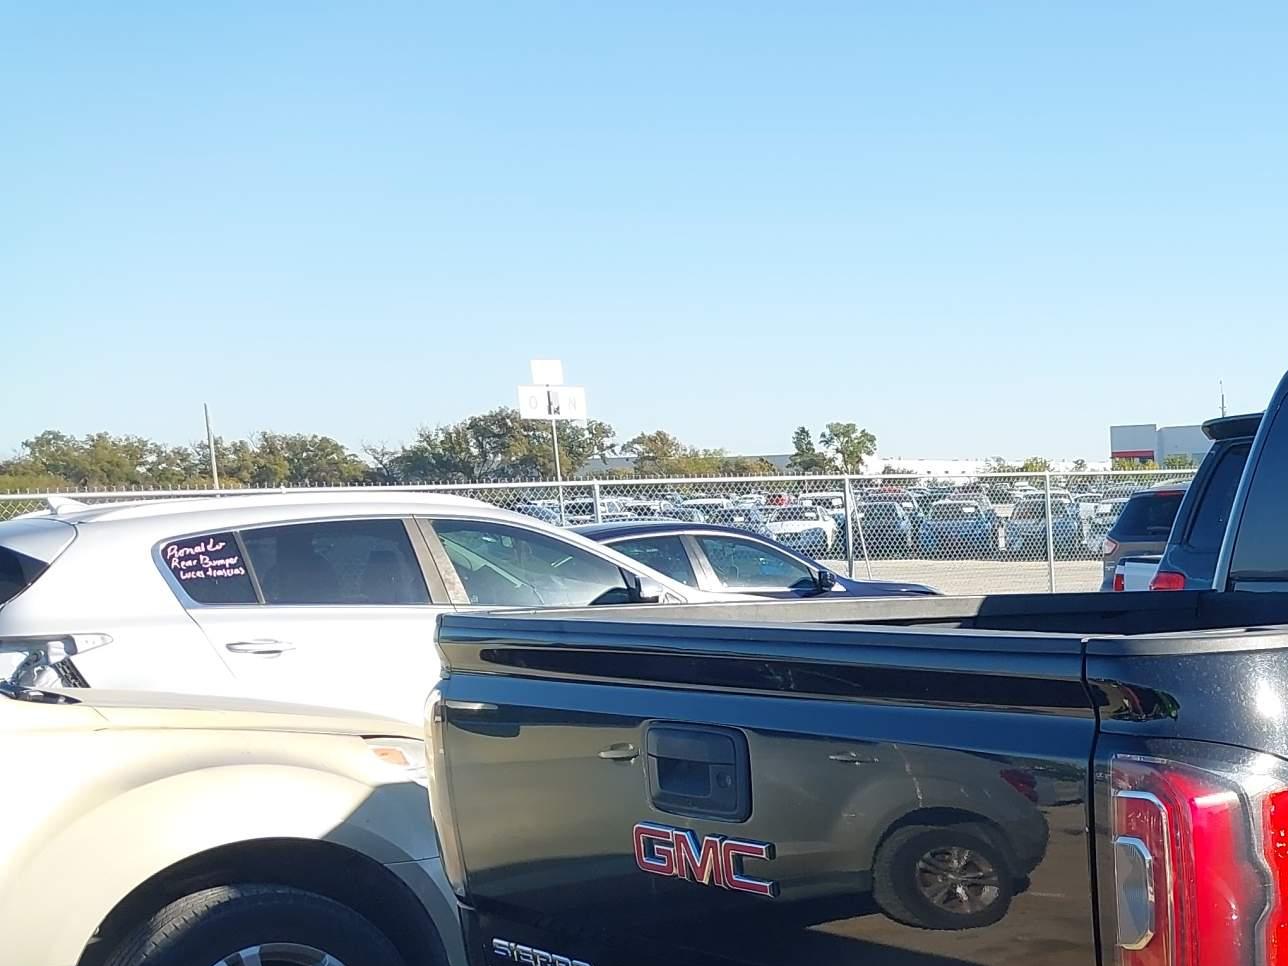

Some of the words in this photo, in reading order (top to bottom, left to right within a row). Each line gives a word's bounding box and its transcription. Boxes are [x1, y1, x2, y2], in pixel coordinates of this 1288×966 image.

[171, 557, 197, 569] Rear
[199, 555, 238, 567] Bumper
[633, 821, 780, 898] GMC
